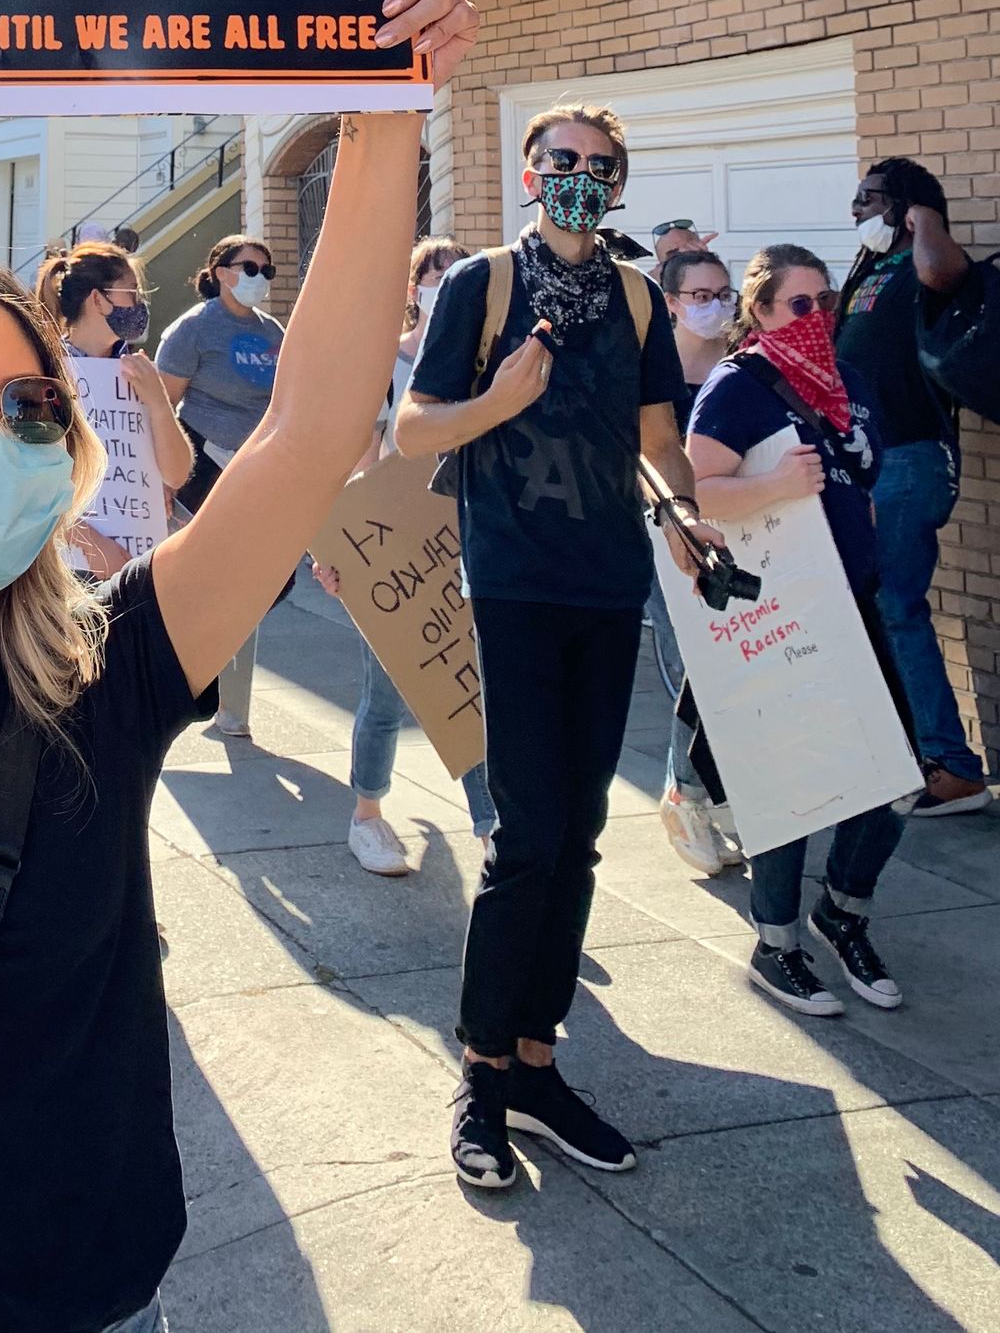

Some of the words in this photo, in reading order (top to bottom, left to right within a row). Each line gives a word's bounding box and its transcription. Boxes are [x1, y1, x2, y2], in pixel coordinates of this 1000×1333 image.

[75, 14, 129, 51] WE
[142, 14, 212, 50] ARE
[224, 14, 286, 50] ALL
[297, 14, 378, 50] FREE
[235, 351, 278, 366] NAS
[709, 597, 781, 643] Systemic
